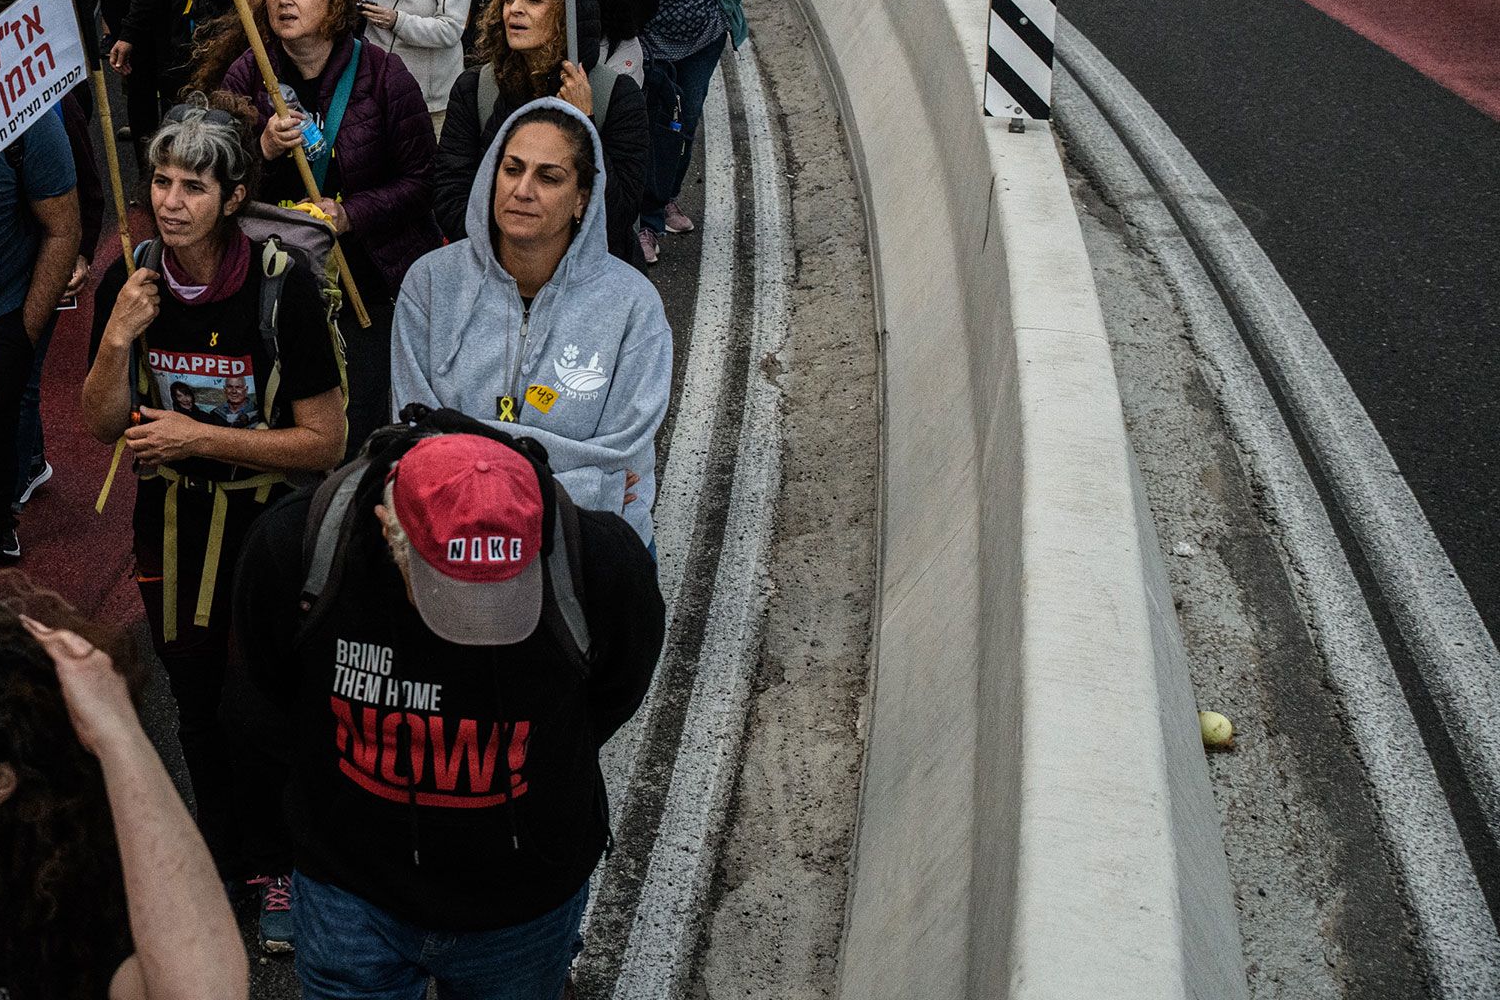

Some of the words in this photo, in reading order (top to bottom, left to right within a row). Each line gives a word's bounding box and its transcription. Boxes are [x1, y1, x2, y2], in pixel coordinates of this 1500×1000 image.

[42, 65, 81, 103] הסכמים
[8, 97, 41, 134] מצילים
[148, 351, 245, 375] DNAPPED
[553, 381, 566, 393] עוז
[566, 389, 577, 399] ניר
[578, 391, 599, 402] קיבוץ
[447, 536, 523, 562] NIKE
[336, 638, 394, 676] BRING
[333, 664, 382, 705] THEM
[386, 679, 442, 711] HOME
[330, 696, 531, 799] NOW!
